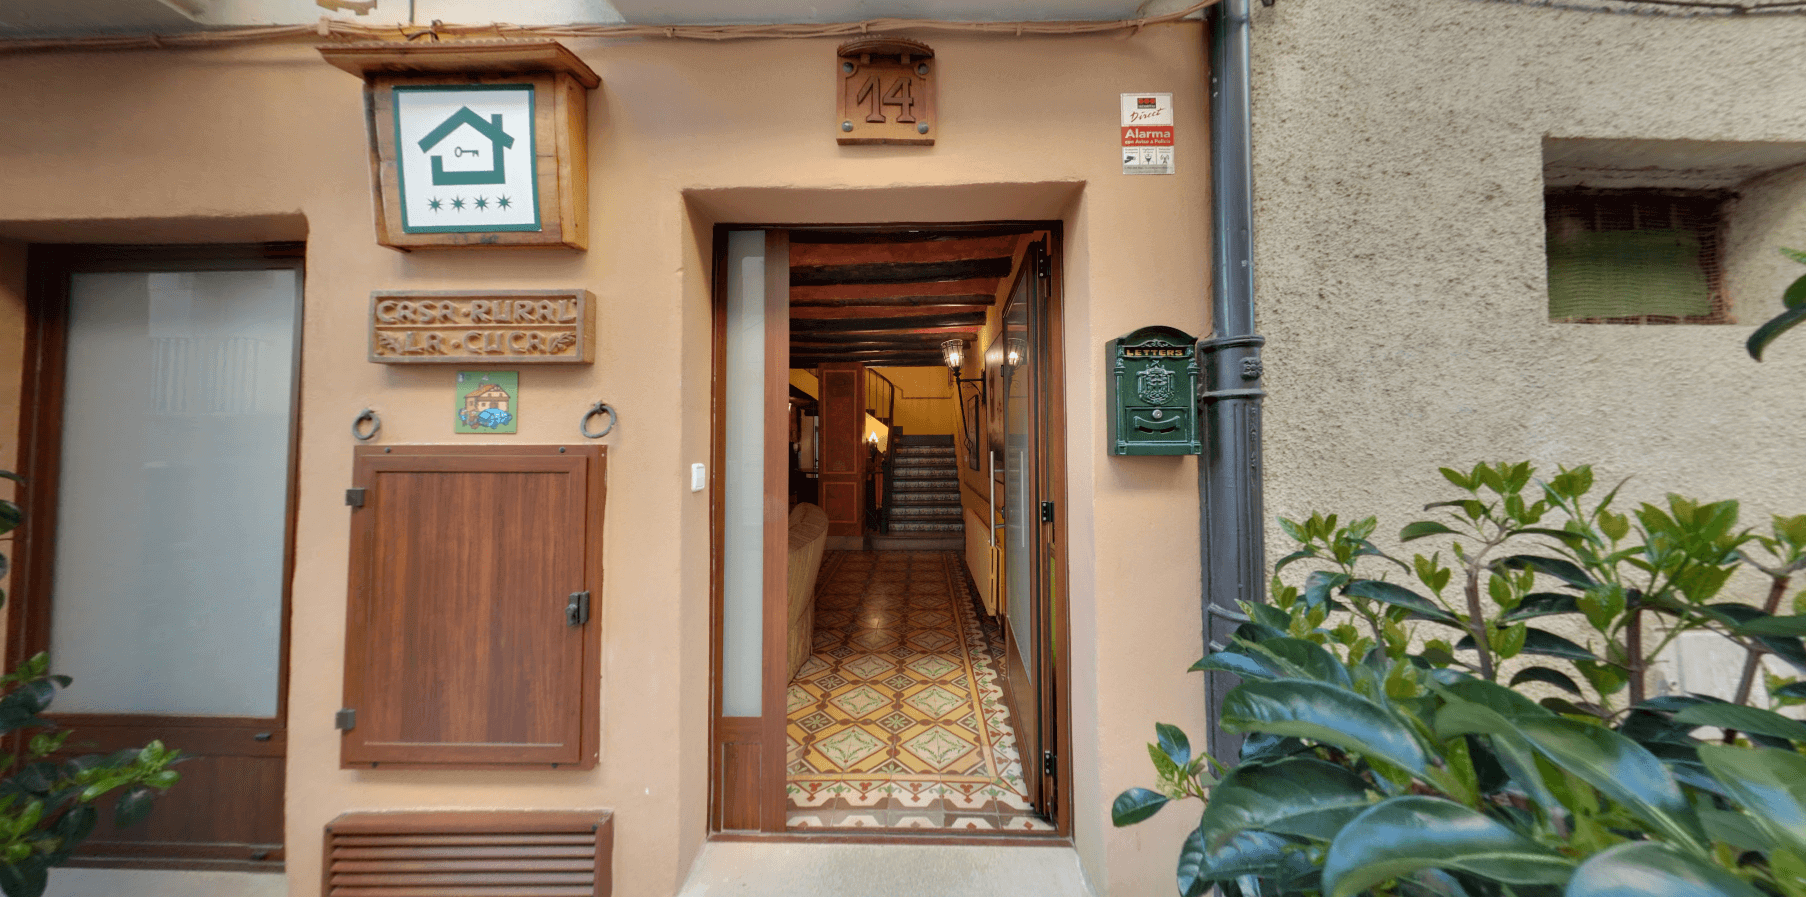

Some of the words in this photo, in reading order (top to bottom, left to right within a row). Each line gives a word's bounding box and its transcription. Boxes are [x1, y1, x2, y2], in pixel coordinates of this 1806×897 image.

[857, 75, 916, 123] 14
[1130, 107, 1165, 122] Direct
[1125, 128, 1171, 139] Alarma
[376, 300, 459, 324] CASA
[470, 300, 576, 324] RURAL
[402, 331, 447, 355] LA
[463, 330, 548, 356] CUCA
